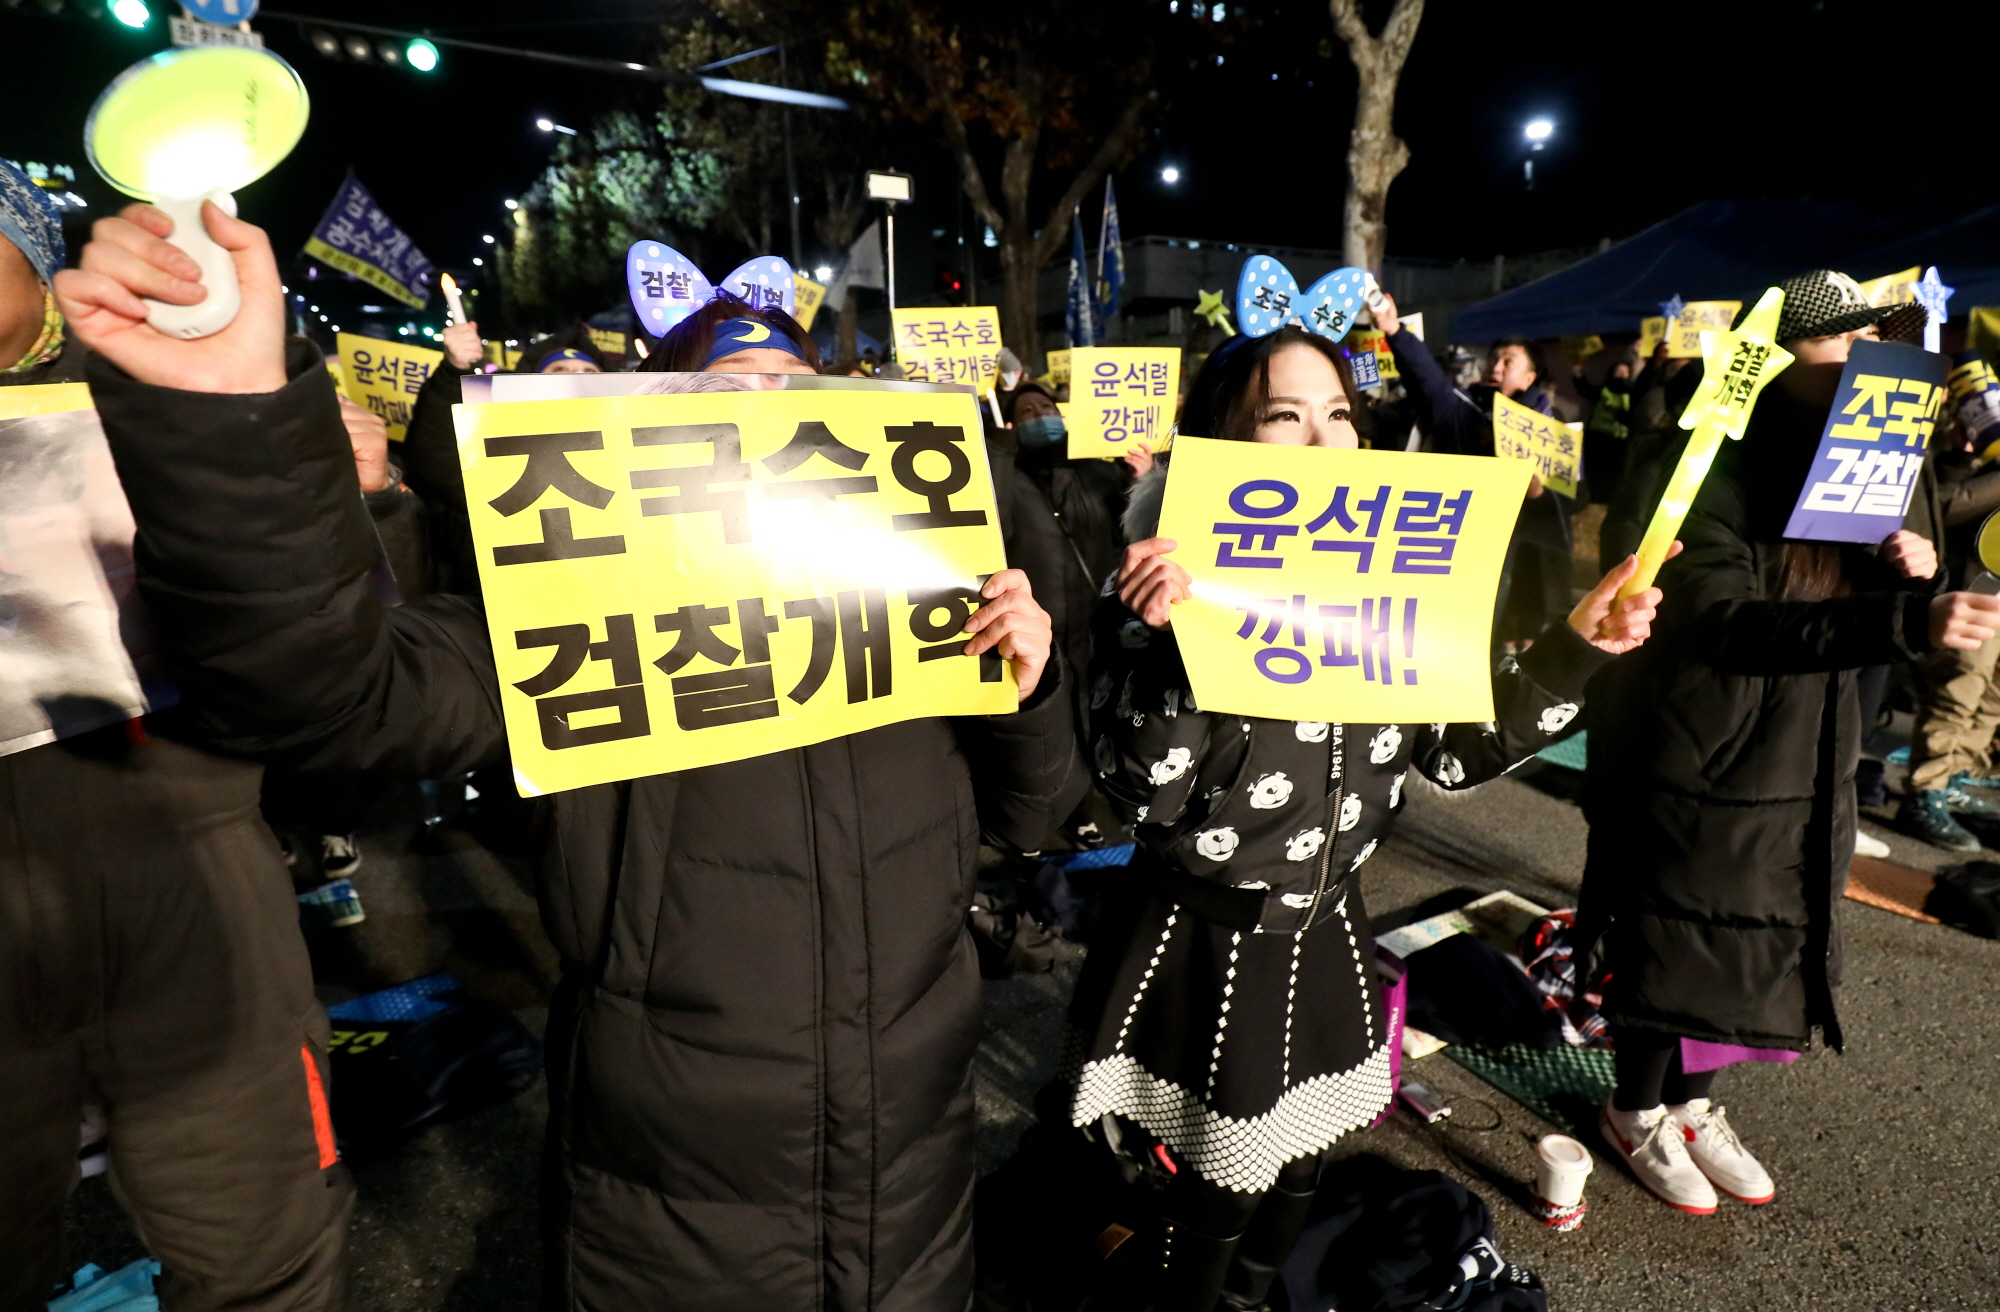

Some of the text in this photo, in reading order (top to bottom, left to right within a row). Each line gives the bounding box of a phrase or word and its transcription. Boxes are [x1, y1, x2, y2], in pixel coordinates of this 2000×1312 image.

[641, 271, 692, 300] 검찰
[740, 282, 784, 310] 개혁
[1252, 286, 1292, 319] 조국
[902, 319, 998, 348] 조국수호
[1313, 303, 1348, 334] 수호
[353, 350, 430, 395] 윤석렬
[1731, 341, 1771, 377] 검찰
[1091, 361, 1168, 397] 윤석렬
[1713, 374, 1756, 410] 개혁
[1100, 405, 1160, 442] 깡패!
[1498, 406, 1576, 459] 조국수호
[484, 420, 988, 567] 조국수호
[1801, 446, 1926, 518] 검찰
[1211, 479, 1474, 576] 윤석렬
[1235, 594, 1418, 686] 깡패!
